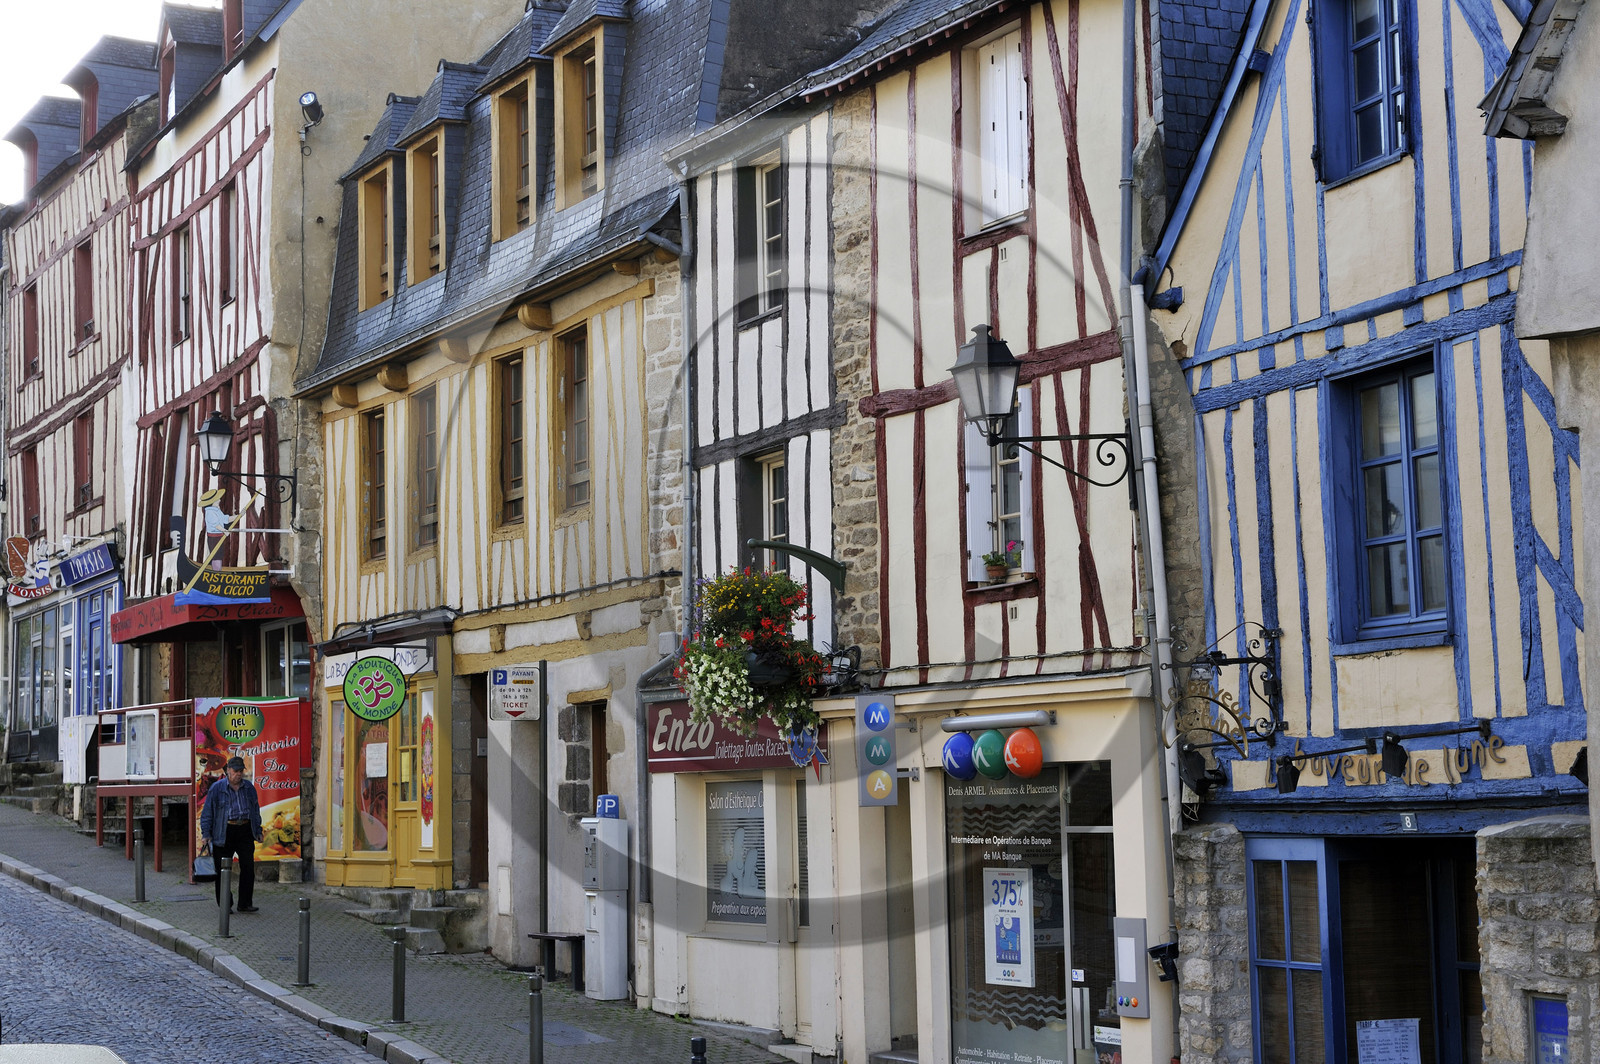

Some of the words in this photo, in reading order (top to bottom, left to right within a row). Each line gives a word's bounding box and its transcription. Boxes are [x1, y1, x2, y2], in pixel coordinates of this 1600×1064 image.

[70, 549, 105, 580] L'OASIS
[202, 572, 267, 585] RISTORANTE
[10, 585, 53, 598] L'OASIS
[208, 585, 221, 594] DA
[224, 585, 254, 596] CICCIO
[197, 604, 229, 619] Da
[237, 603, 284, 618] Ciccio
[389, 649, 418, 667] ONDE
[357, 660, 403, 687] BOUTIQUE
[496, 672, 504, 683] P
[223, 706, 258, 717] L'ITALIA
[352, 701, 361, 711] du
[363, 700, 399, 718] MONDE
[231, 718, 246, 727] NEL
[869, 711, 885, 724] M
[223, 730, 258, 739] PIATTO
[652, 707, 715, 752] Enzo
[228, 736, 300, 758] Trattoria
[714, 741, 744, 764] Toilettage
[744, 739, 765, 758] Toutes
[870, 744, 886, 757] M
[1003, 743, 1021, 768] A
[1265, 756, 1279, 789] L
[1294, 737, 1383, 785] buveur
[1442, 735, 1506, 784] lune
[263, 758, 289, 772] Da
[254, 776, 299, 790] Ciccio
[873, 777, 886, 792] A
[948, 786, 963, 796] Denis
[964, 786, 986, 796] ARMEL
[989, 785, 1018, 795] Assurances
[1019, 785, 1025, 794] &
[1026, 784, 1058, 794] Placements
[605, 799, 616, 813] P
[709, 791, 724, 809] Salon
[724, 790, 757, 813] d'Esthétique
[1404, 816, 1412, 828] 8
[950, 835, 984, 845] Intermédiaire
[985, 837, 992, 845] en
[992, 835, 1021, 847] Opérations
[1023, 836, 1030, 845] de
[1031, 836, 1051, 847] Banque
[983, 851, 991, 860] de
[992, 851, 1001, 860] MA
[1002, 851, 1023, 862] Banque
[991, 879, 1023, 908] 3,75%
[711, 901, 740, 918] Préparation
[740, 905, 750, 915] aux
[957, 1046, 983, 1057] Automobile
[986, 1049, 1010, 1060] Habitation
[1014, 1052, 1033, 1063] Retraite
[1036, 1056, 1063, 1064] Placements
